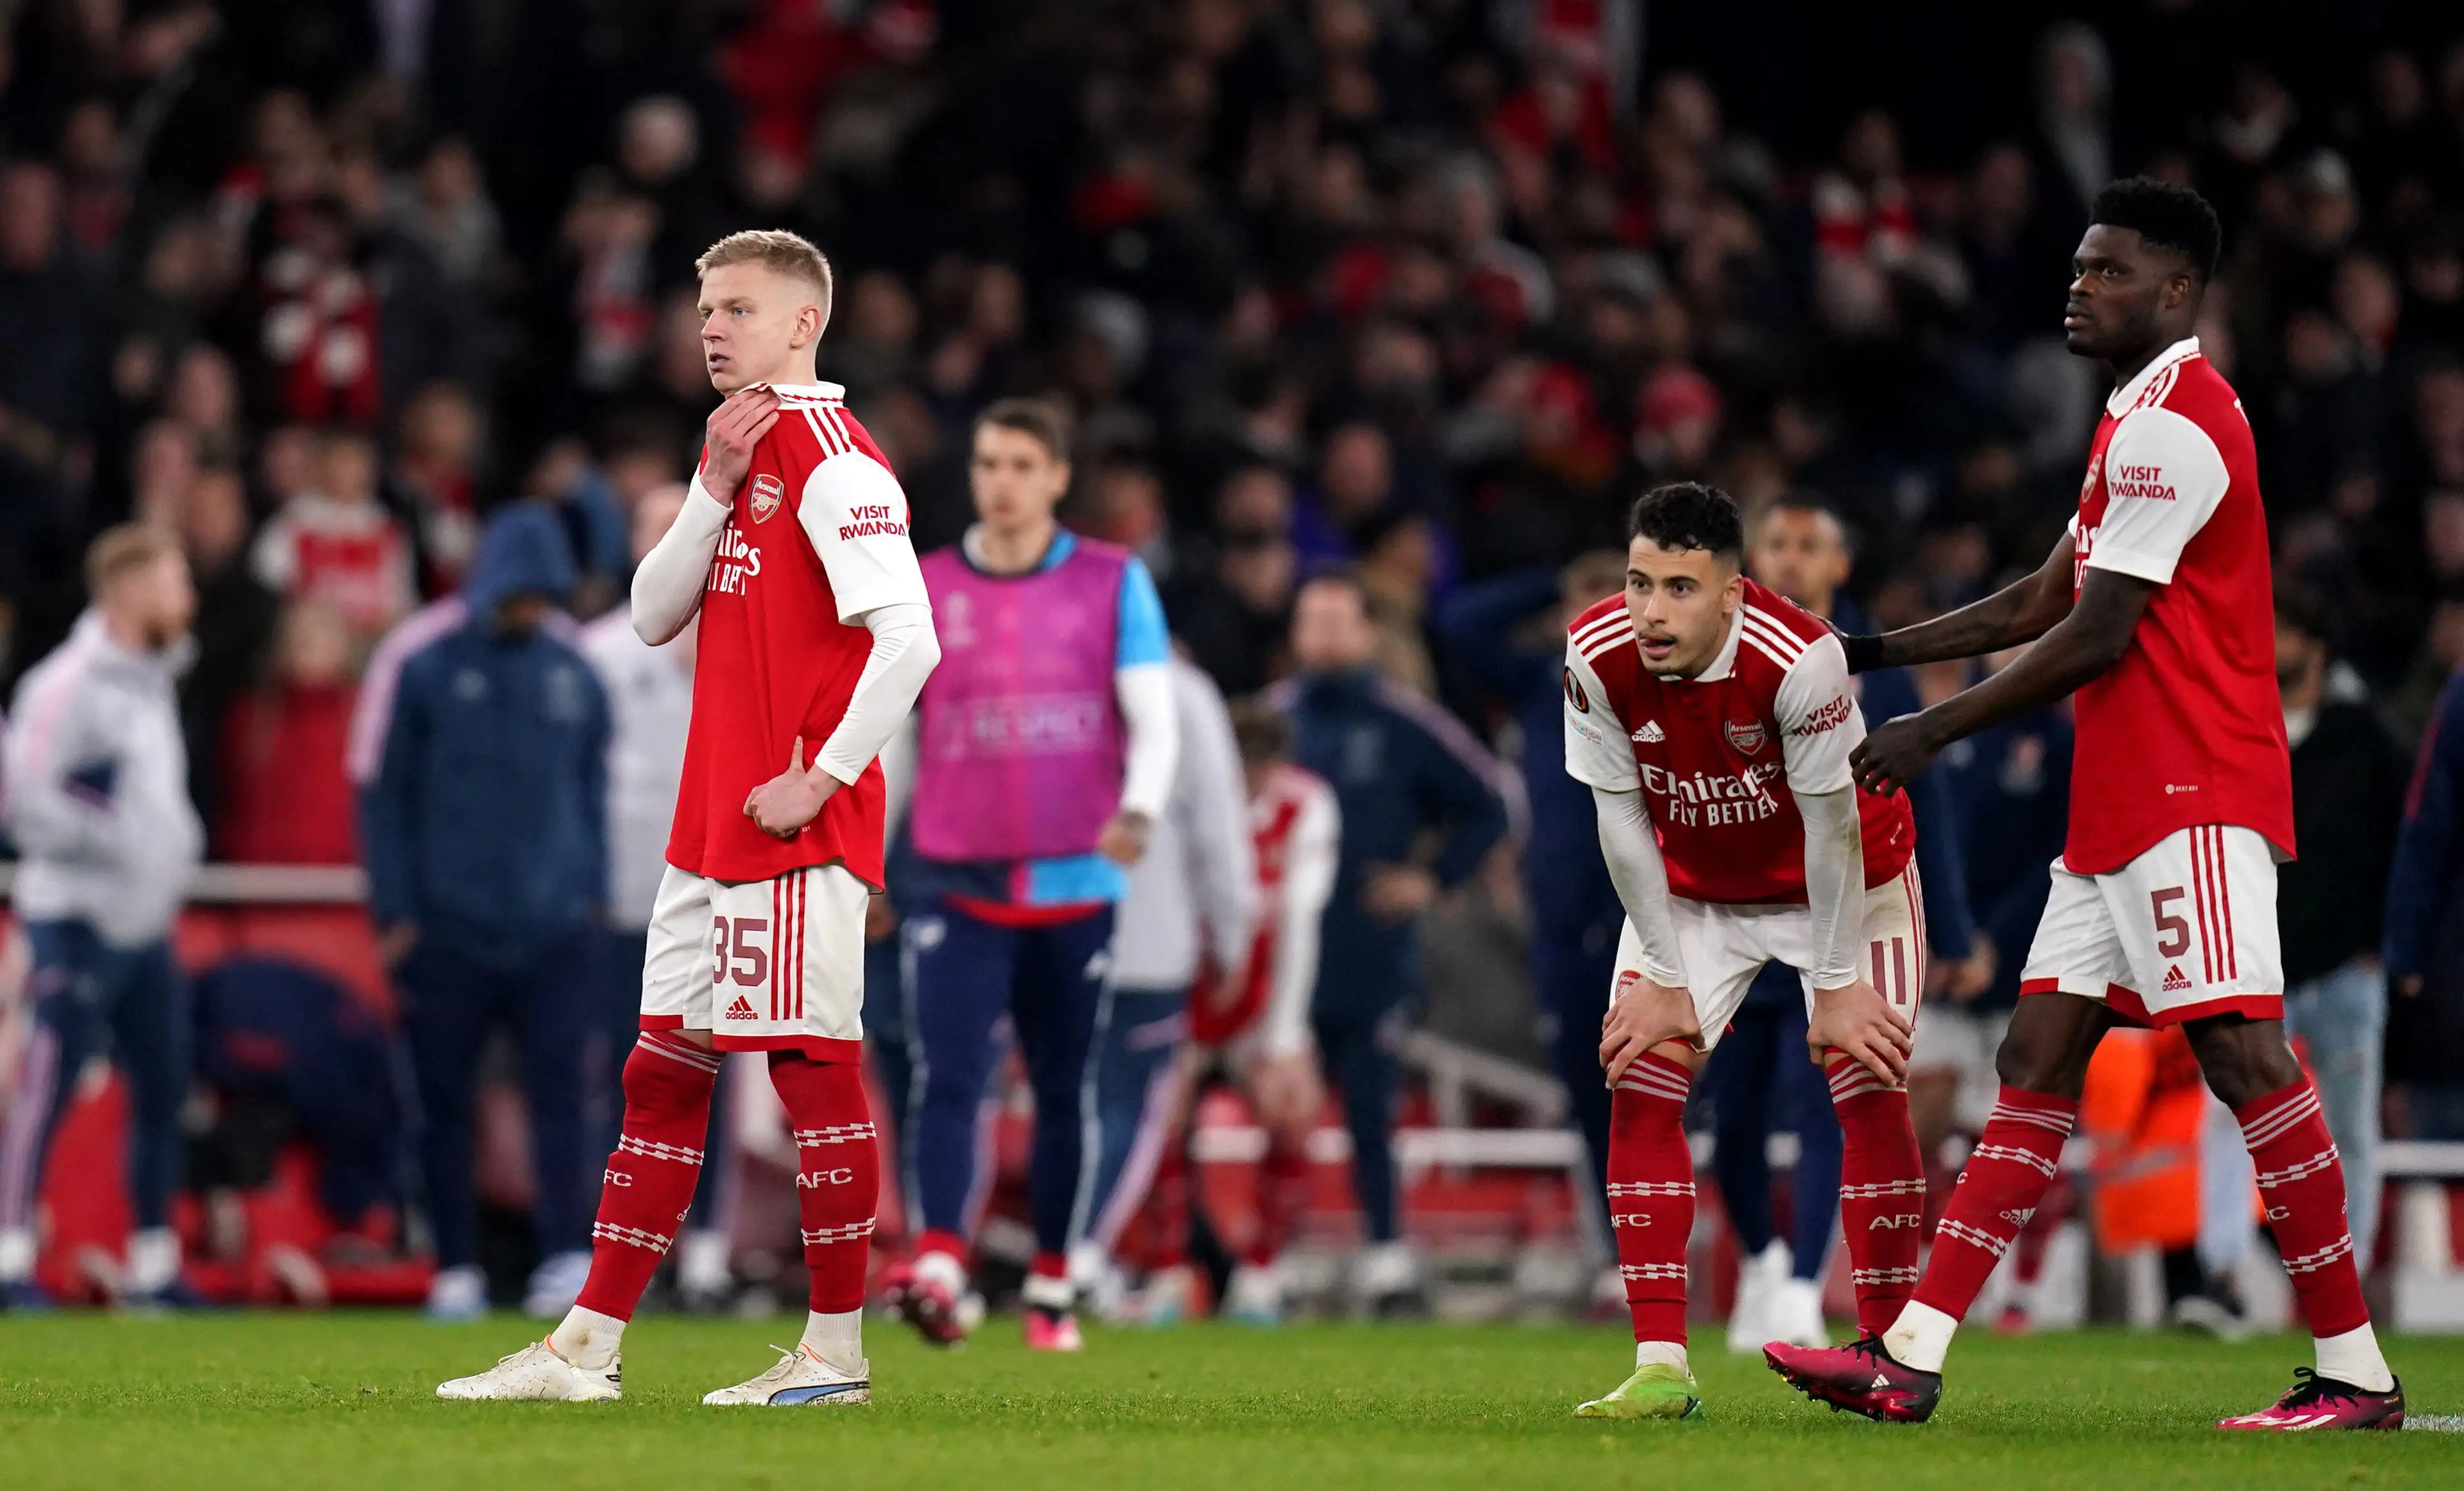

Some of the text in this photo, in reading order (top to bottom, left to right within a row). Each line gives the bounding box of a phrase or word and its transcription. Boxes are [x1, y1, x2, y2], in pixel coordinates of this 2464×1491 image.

[2120, 465, 2162, 481] VISIT
[756, 480, 779, 495] Arsenal
[850, 506, 890, 521] VISIT
[839, 521, 907, 540] RWANDA
[1806, 694, 1843, 722] VISIT
[1731, 723, 1761, 732] Arsenal
[1639, 761, 1782, 803] Emirates
[1670, 799, 1697, 827] FLY
[2151, 886, 2191, 958] 5
[714, 916, 767, 987] 35
[1870, 937, 1906, 1005] 11
[725, 1012, 758, 1020] adidas
[604, 1168, 633, 1187] FC
[796, 1168, 853, 1189] AFC
[1869, 1214, 1921, 1230] AFC
